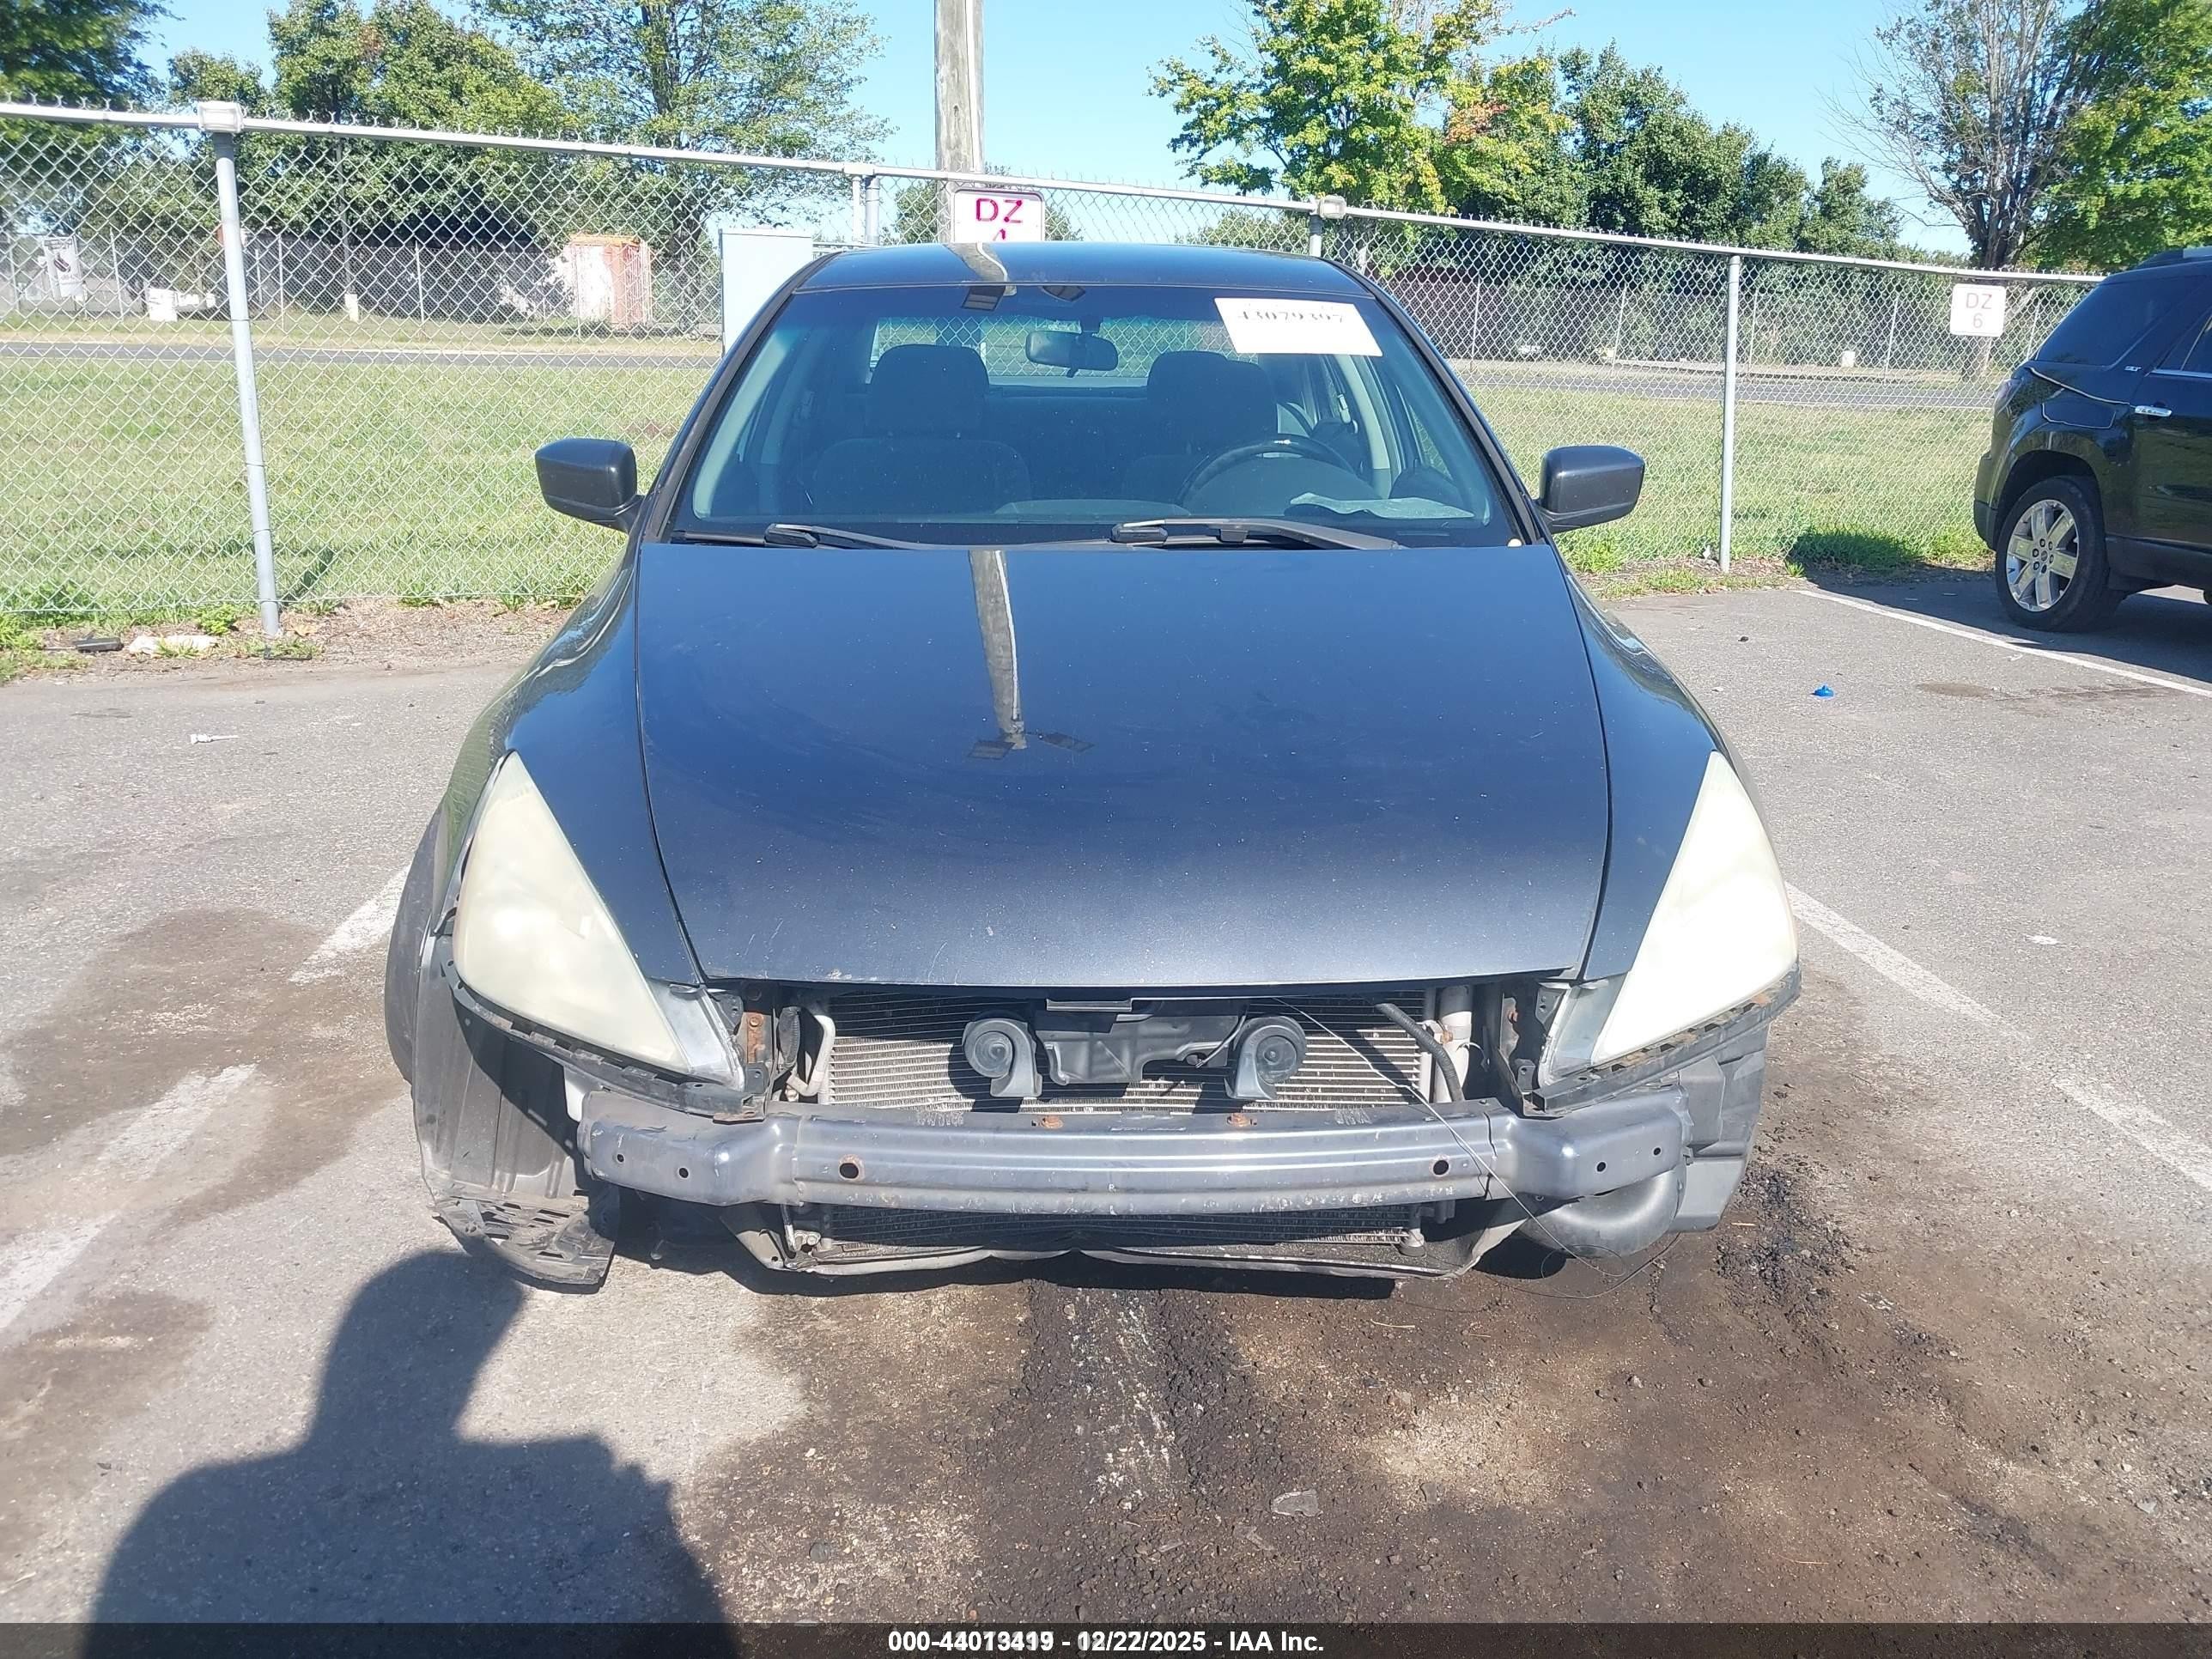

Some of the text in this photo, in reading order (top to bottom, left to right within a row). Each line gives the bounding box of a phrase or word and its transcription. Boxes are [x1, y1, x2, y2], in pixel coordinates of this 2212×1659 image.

[975, 198, 1023, 223] DZ
[1966, 293, 1992, 310] DZ
[1972, 313, 1983, 329] 6
